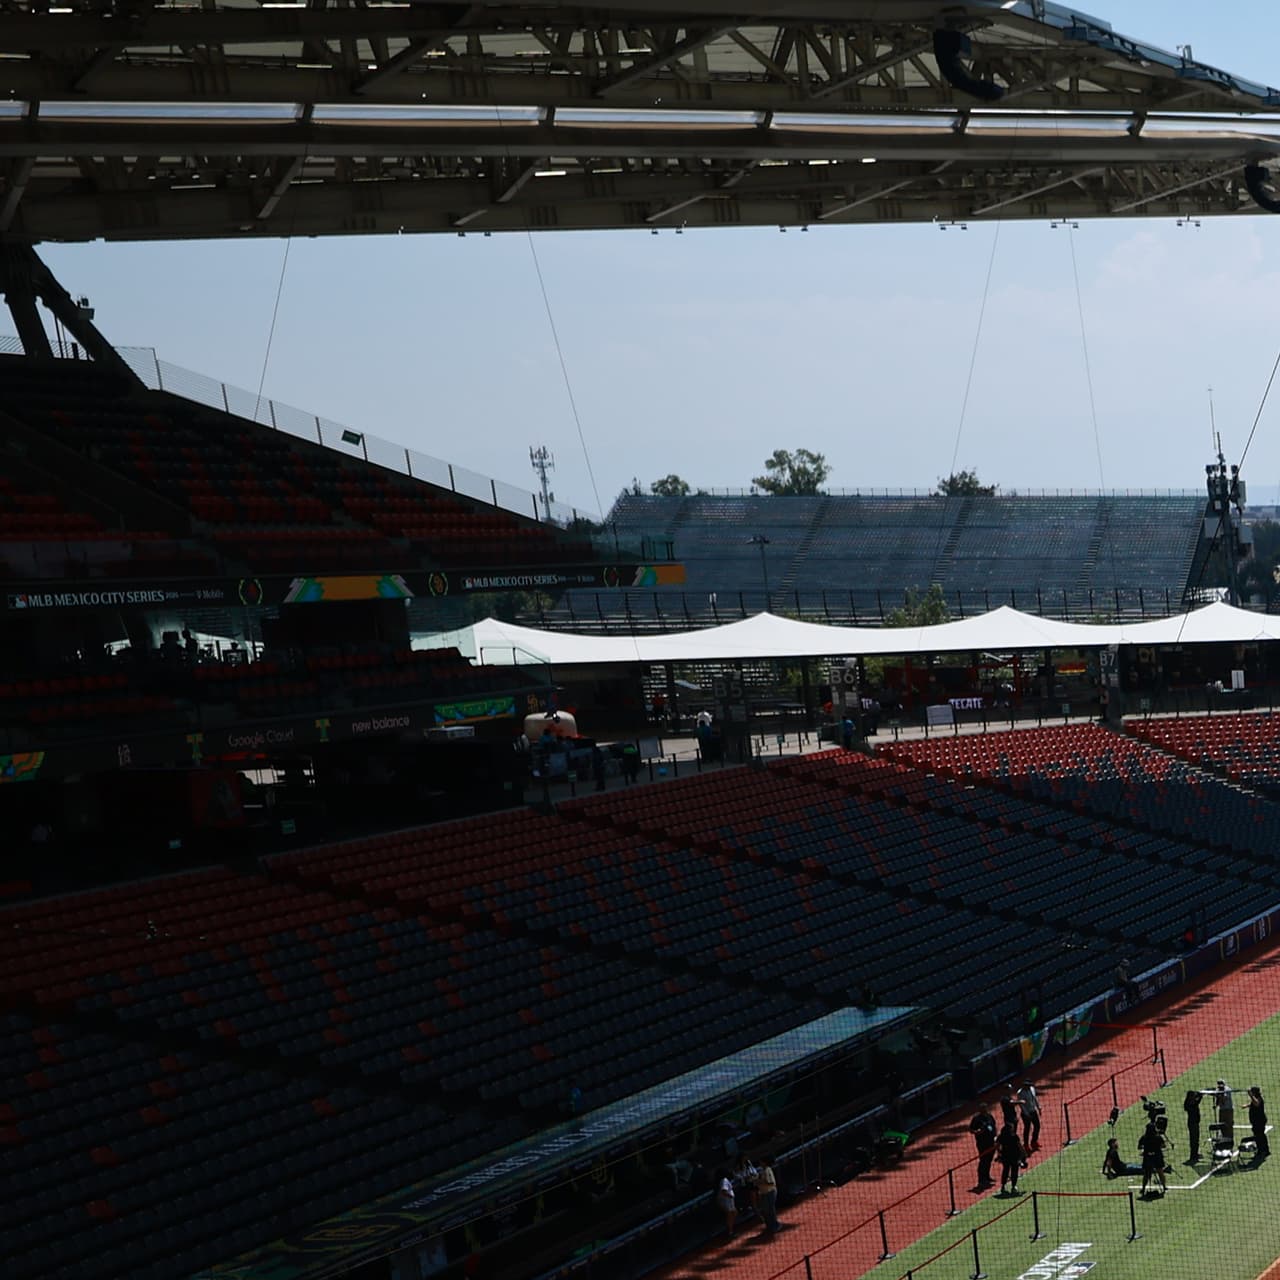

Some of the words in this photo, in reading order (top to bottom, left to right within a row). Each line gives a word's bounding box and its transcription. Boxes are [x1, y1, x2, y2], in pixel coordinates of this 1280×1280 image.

[517, 576, 533, 586] CITY
[534, 574, 558, 585] SERIES
[28, 594, 53, 607] MLB
[54, 592, 99, 606] MEXICO
[100, 592, 125, 605] CITY
[126, 590, 164, 604] SERIES
[1100, 653, 1115, 667] B7
[830, 669, 855, 685] B6
[714, 681, 742, 698] B5
[949, 697, 985, 710] TECATE
[352, 722, 371, 736] new
[372, 715, 410, 730] balance
[228, 734, 264, 749] Google
[266, 728, 294, 744] Cloud
